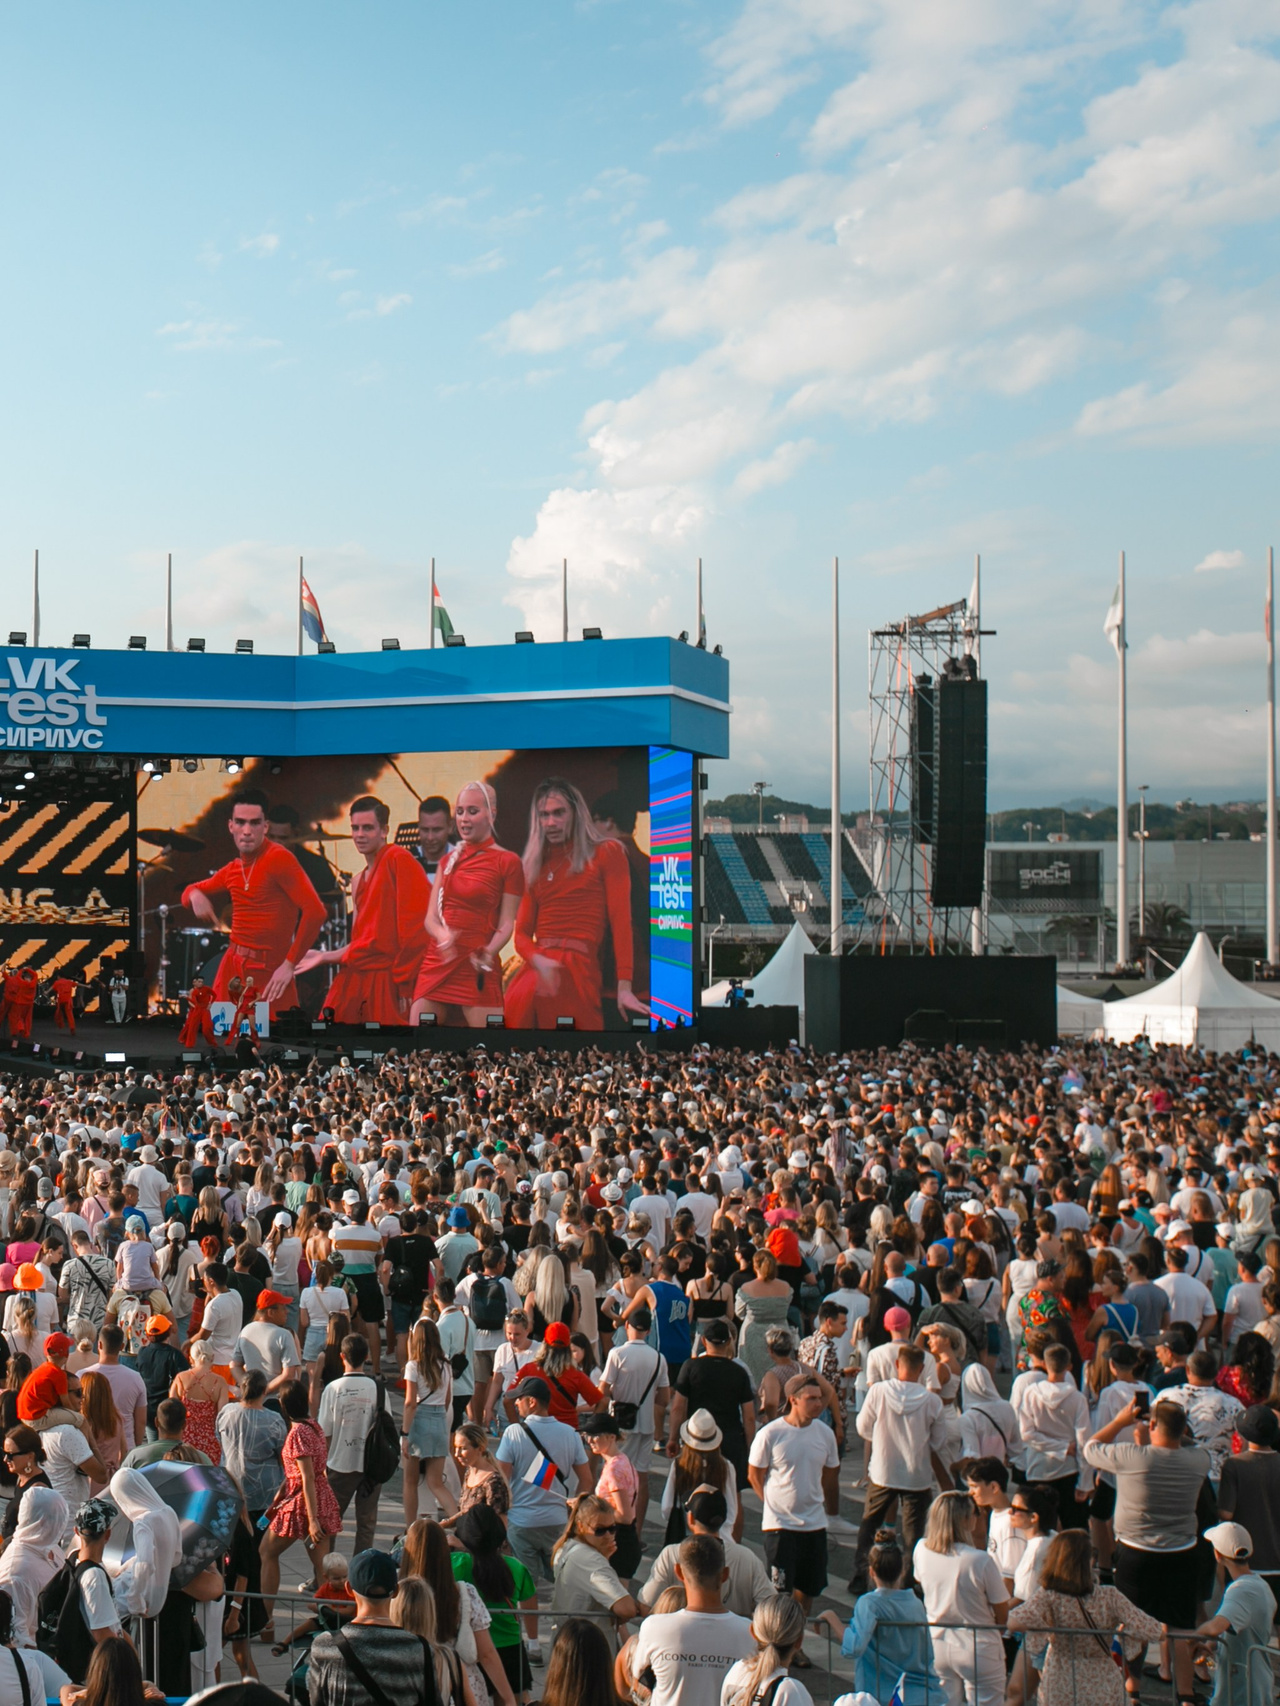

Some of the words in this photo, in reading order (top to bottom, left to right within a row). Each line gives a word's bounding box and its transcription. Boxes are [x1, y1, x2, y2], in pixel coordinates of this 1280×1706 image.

[6, 656, 81, 691] VK
[662, 856, 679, 882] VK
[1019, 869, 1071, 879] SOCHI
[659, 873, 685, 909] fest
[661, 1652, 697, 1662] ICONO
